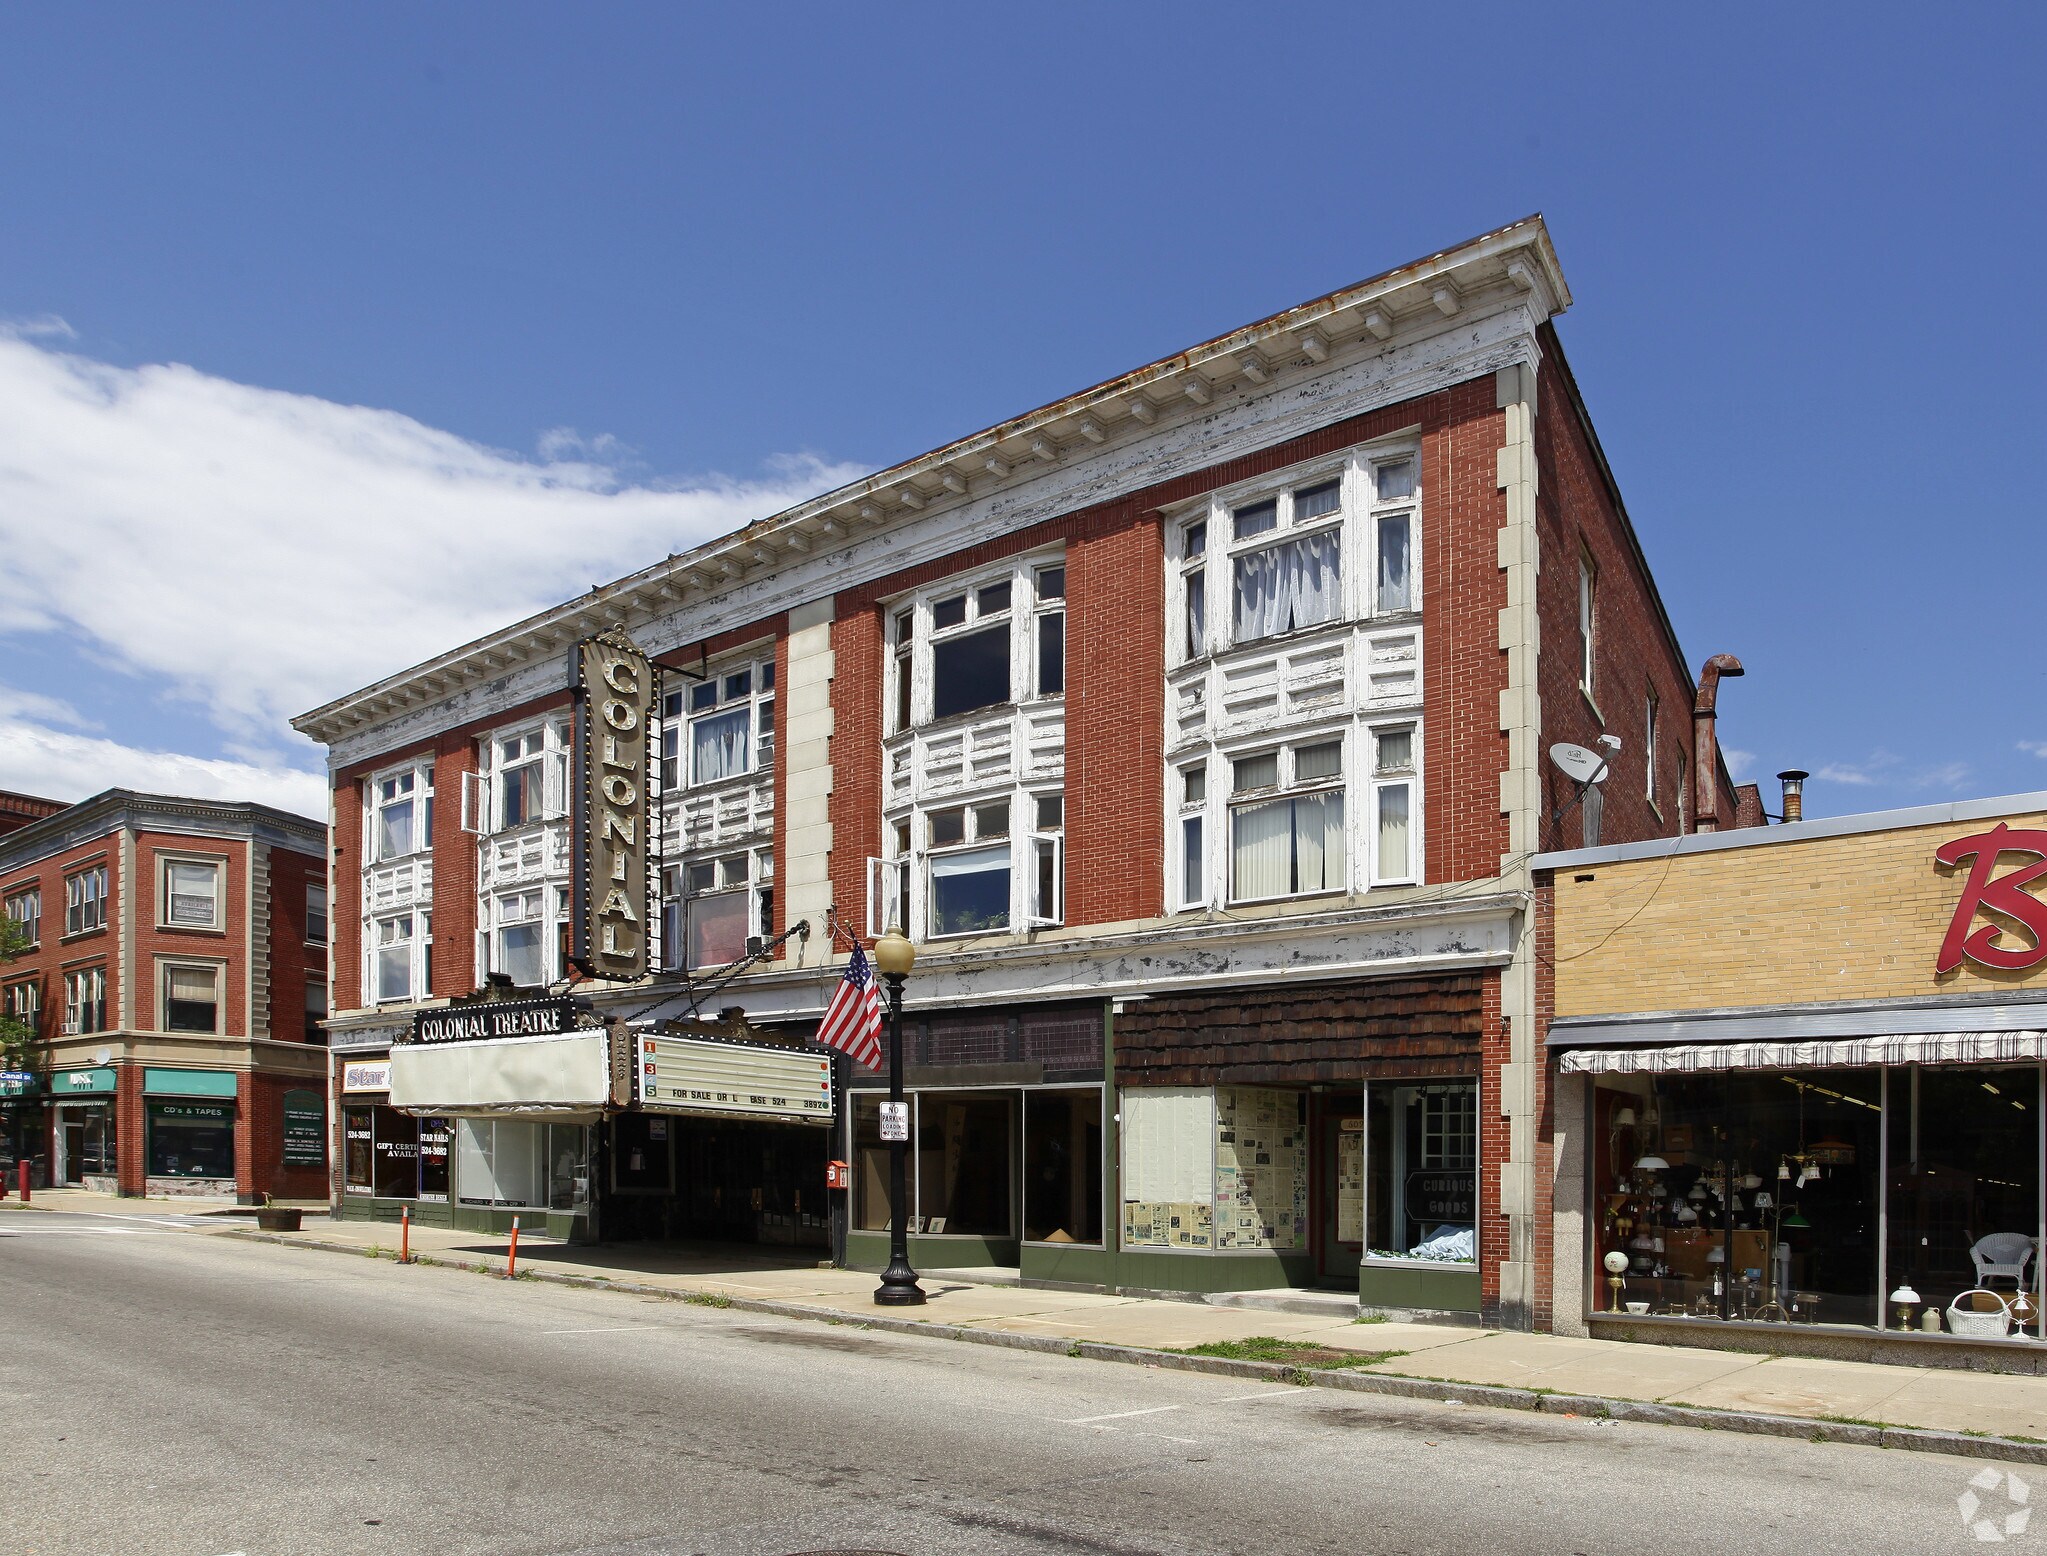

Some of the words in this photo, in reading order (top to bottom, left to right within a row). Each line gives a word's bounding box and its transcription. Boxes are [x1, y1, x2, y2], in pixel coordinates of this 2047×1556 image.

[598, 657, 638, 958] COLONIAL
[422, 1013, 489, 1041] COLONIAL
[492, 1007, 561, 1035] THEATRE
[646, 1042, 653, 1052] 1
[645, 1053, 656, 1063] 2
[646, 1064, 655, 1074] 3
[0, 1072, 23, 1080] Canal
[347, 1068, 385, 1087] Star
[647, 1086, 656, 1096] 5
[672, 1088, 687, 1099] FOR
[691, 1090, 711, 1101] SALE
[717, 1091, 727, 1101] OR
[772, 1097, 786, 1106] 524
[163, 1106, 183, 1114] CD's
[195, 1108, 222, 1116] TAPES
[888, 1106, 899, 1114] NO
[882, 1114, 905, 1123] PARKING
[420, 1133, 433, 1142] STAR
[434, 1133, 449, 1143] NAILS
[376, 1142, 393, 1150] GIFT
[1423, 1179, 1474, 1192] CURIOUS
[1429, 1200, 1468, 1214] GOODS
